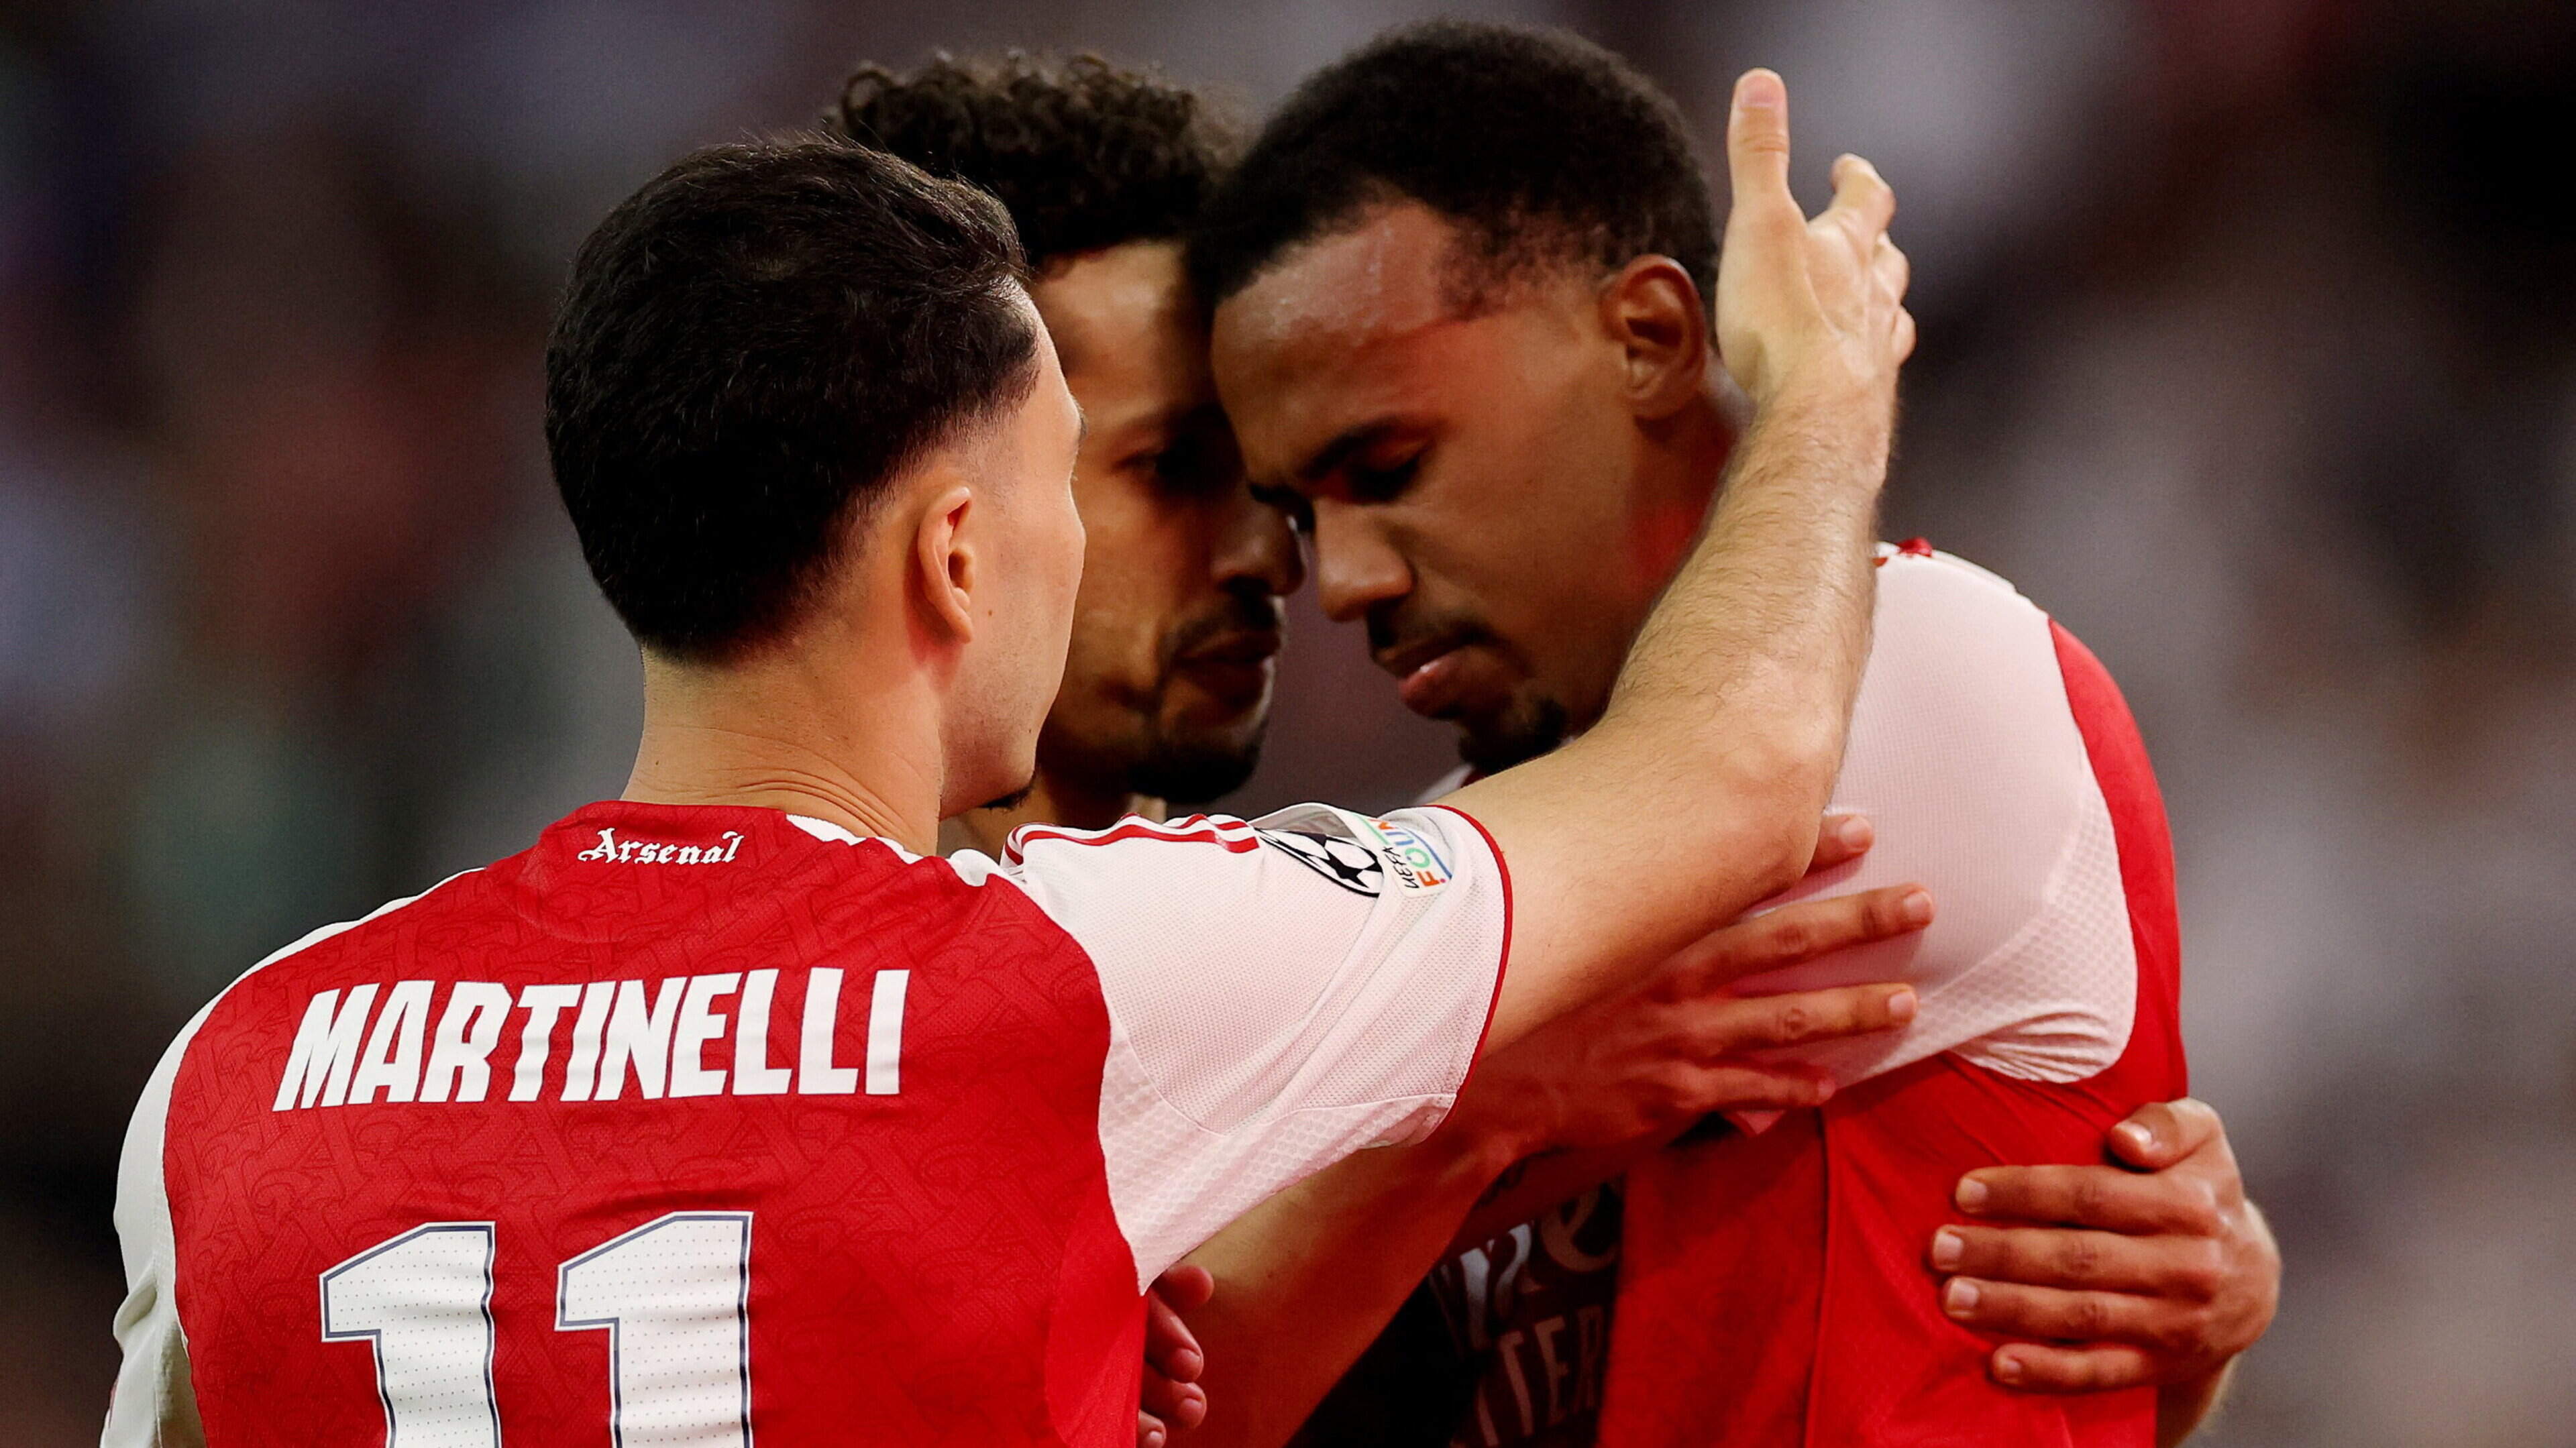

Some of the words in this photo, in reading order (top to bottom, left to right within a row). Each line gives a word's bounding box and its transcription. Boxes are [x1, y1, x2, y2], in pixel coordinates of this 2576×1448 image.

[578, 828, 744, 865] Arsenal
[1382, 846, 1419, 889] UEFA
[272, 967, 910, 1112] MARTINELLI
[319, 1211, 754, 1448] 11
